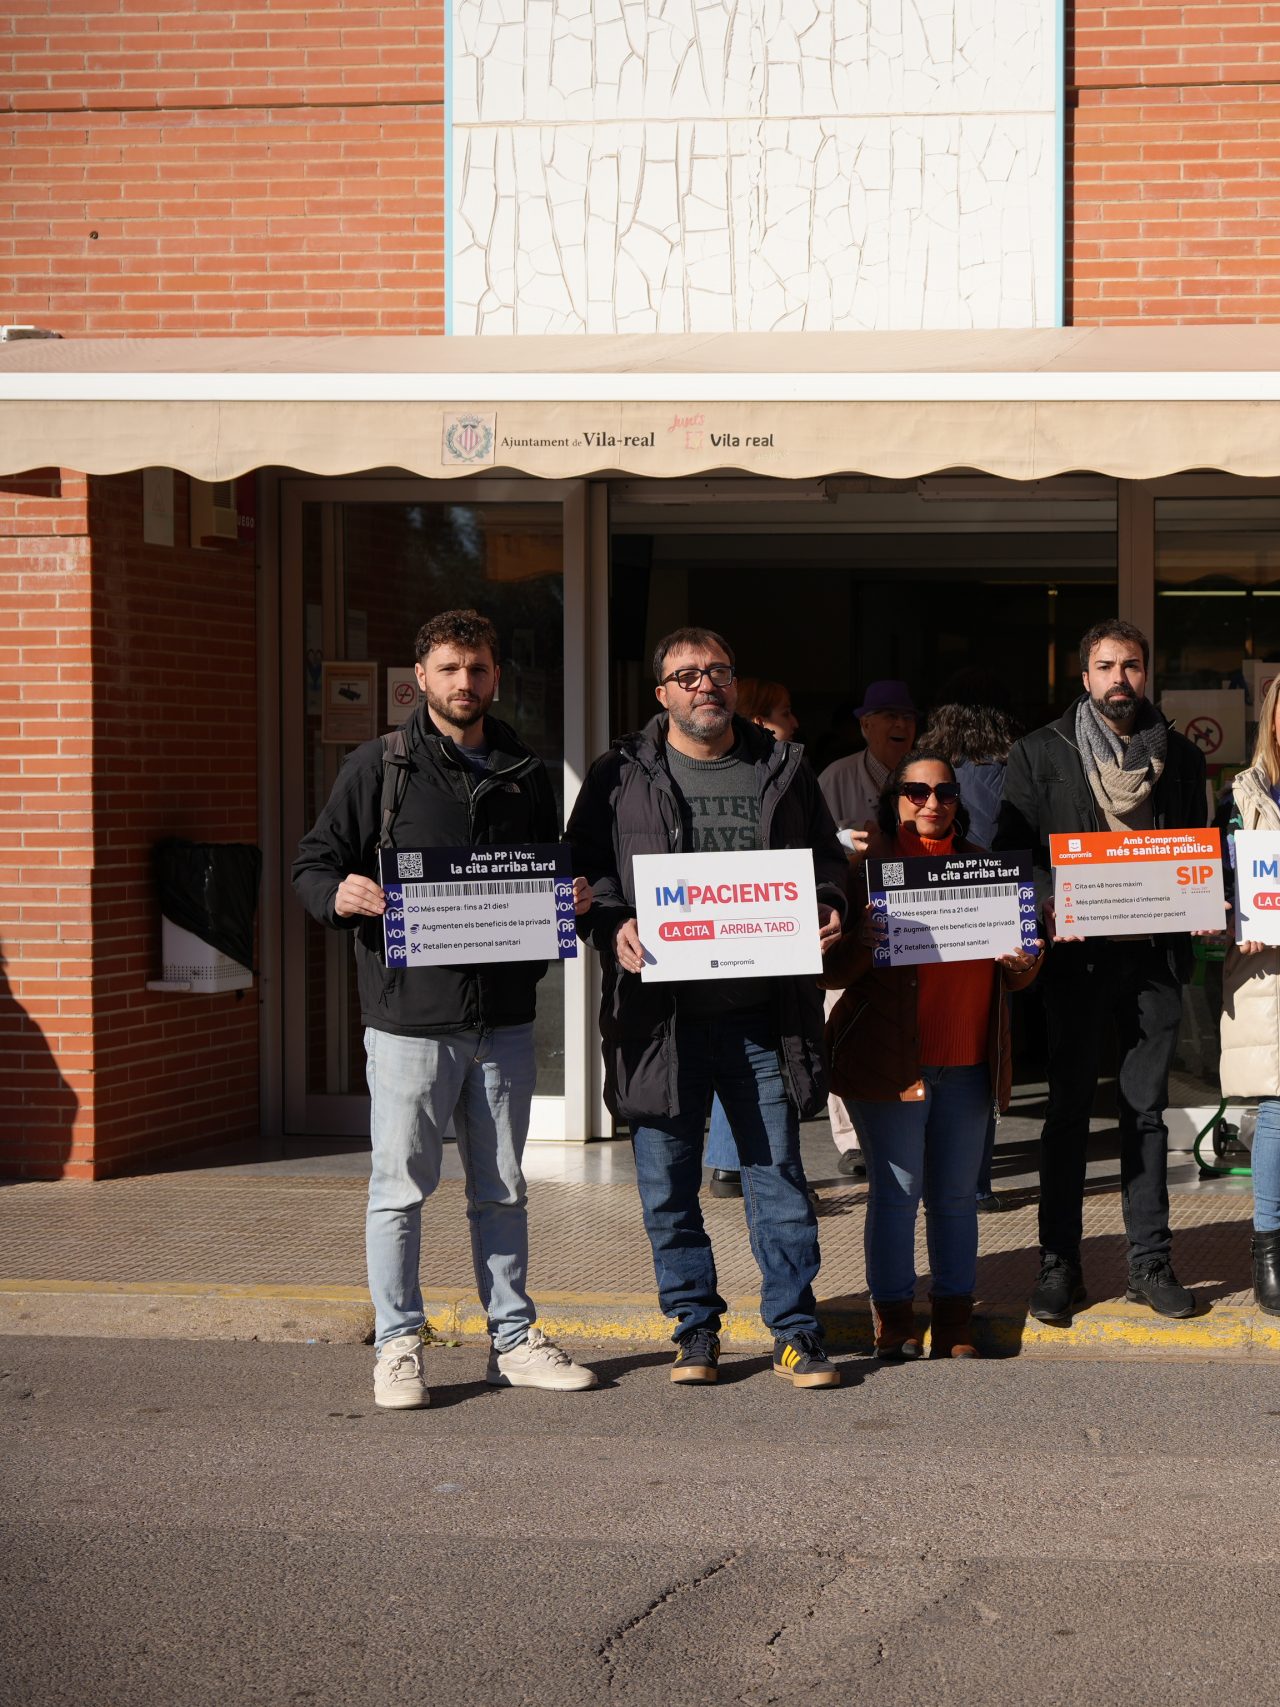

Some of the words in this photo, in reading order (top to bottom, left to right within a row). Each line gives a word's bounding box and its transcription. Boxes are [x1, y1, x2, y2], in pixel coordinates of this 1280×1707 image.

[501, 436, 569, 448] Ajuntament
[572, 438, 582, 447] de
[584, 432, 655, 447] Vila-real
[711, 434, 739, 447] Vila
[746, 434, 774, 447] real
[1123, 837, 1142, 845] Amb
[1145, 835, 1195, 844] Compromís:
[471, 853, 492, 861] Amb
[495, 852, 507, 860] PP
[509, 852, 512, 860] i
[515, 852, 535, 860] Vox:
[1107, 846, 1130, 856] més
[1133, 846, 1170, 855] sanitat
[1173, 844, 1213, 855] pública
[451, 864, 462, 874] la
[466, 862, 488, 873] cita
[491, 862, 528, 873] arriba
[531, 861, 556, 871] tard
[928, 872, 938, 881] la
[941, 871, 960, 881] cita
[963, 869, 996, 879] arriba
[998, 867, 1019, 877] tard
[1176, 865, 1213, 885] SIP
[656, 882, 798, 906] IMPACIENTS
[1258, 896, 1272, 906] LA
[422, 923, 463, 931] Augmenten
[525, 918, 551, 927] privada
[1091, 914, 1108, 922] temps
[664, 926, 681, 938] LA
[684, 925, 709, 936] CITA
[720, 923, 762, 934] ARRIBA
[764, 922, 794, 932] TARD
[903, 925, 938, 933] Augmenten
[993, 919, 1015, 927] privada
[464, 940, 493, 949] personal
[495, 939, 521, 947] sanitari
[939, 941, 965, 949] personal
[720, 959, 755, 967] compromís
